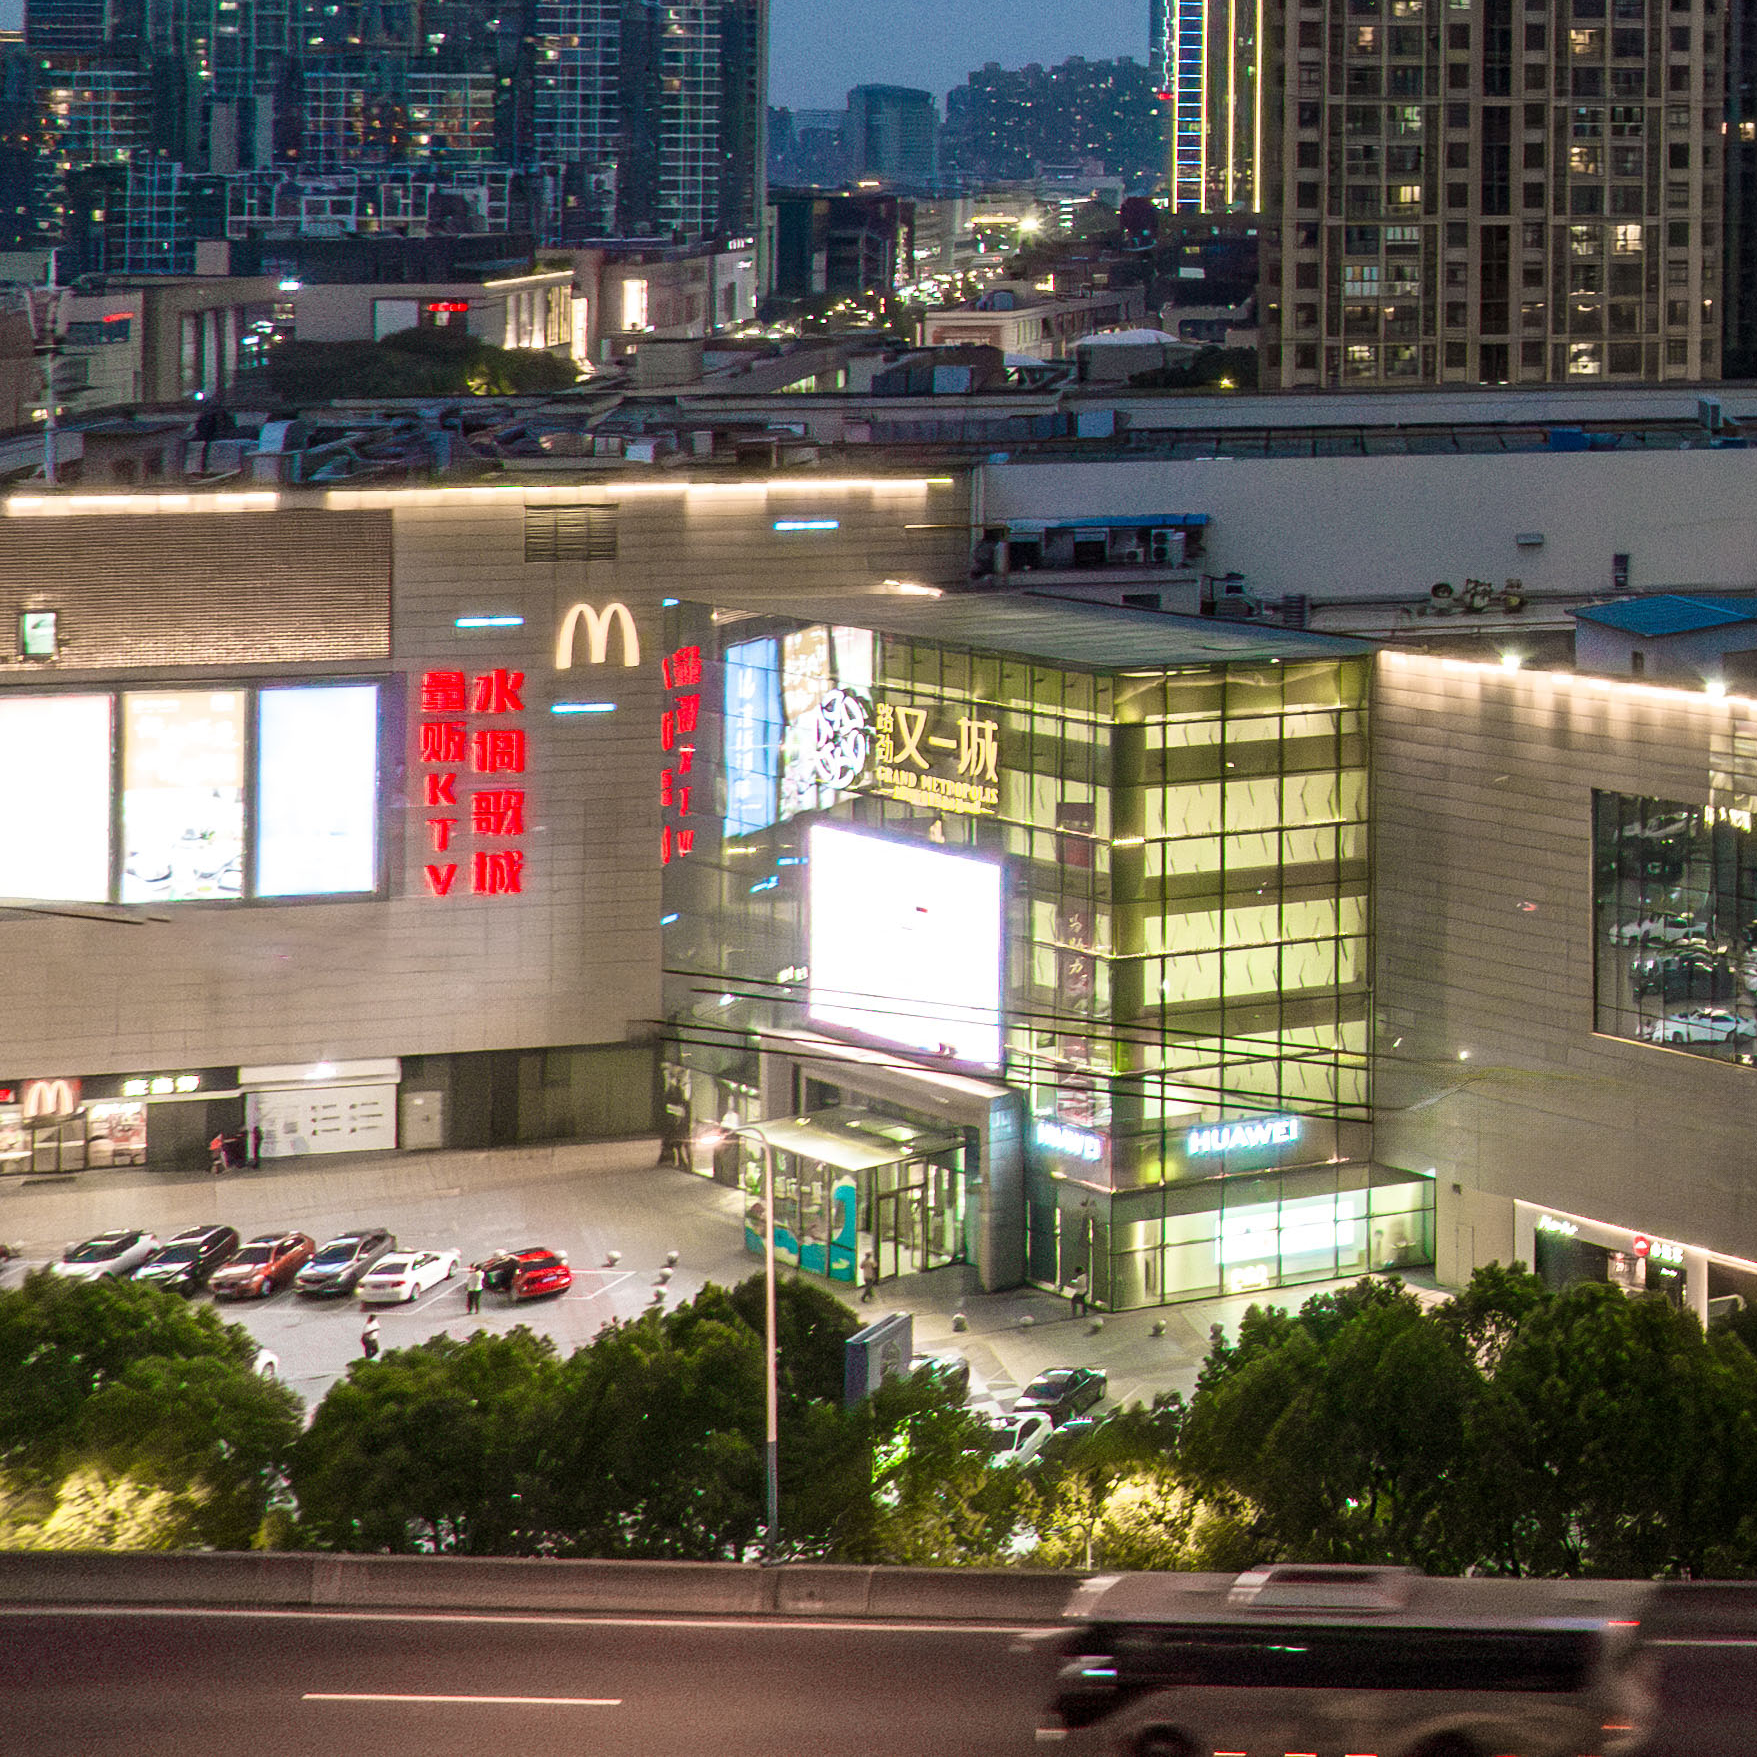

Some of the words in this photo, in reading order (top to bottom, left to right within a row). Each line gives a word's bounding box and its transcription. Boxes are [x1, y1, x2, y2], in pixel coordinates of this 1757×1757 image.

[471, 668, 525, 895] 水调歌城
[876, 765, 918, 788] GRAND
[920, 774, 999, 805] METROPOLIS
[1188, 1118, 1300, 1156] HUAWEI
